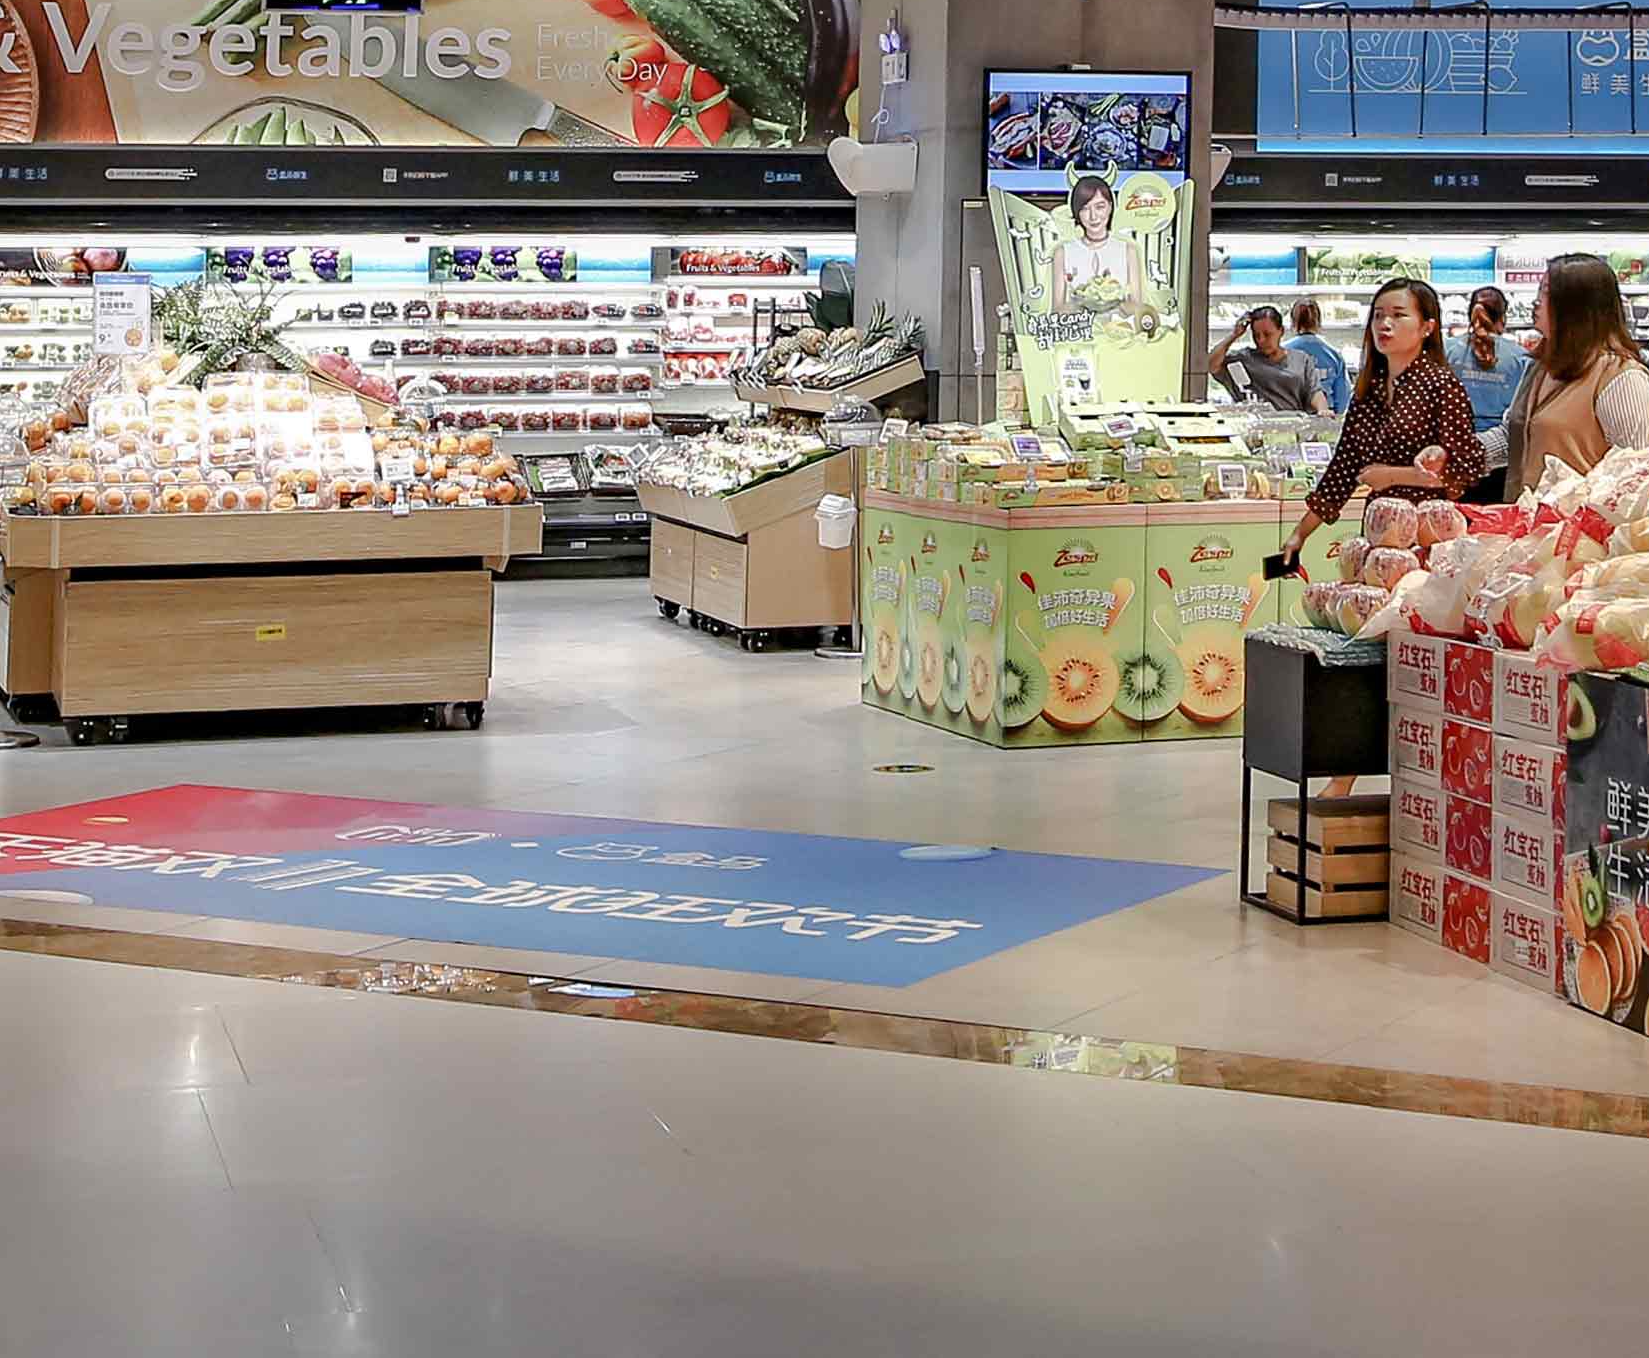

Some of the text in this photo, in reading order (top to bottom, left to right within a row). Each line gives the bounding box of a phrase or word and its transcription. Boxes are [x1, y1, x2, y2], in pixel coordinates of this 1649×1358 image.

[43, 3, 513, 93] Vegetables
[536, 23, 609, 48] Fresh
[536, 56, 669, 85] Every Day
[1399, 642, 1431, 670] 红宝石
[1505, 668, 1543, 699] 红宝石
[1399, 717, 1431, 748] 红宝石
[1502, 750, 1539, 782] 红宝石
[1401, 791, 1434, 822] 红宝石
[1503, 826, 1540, 862] 红宝石
[1400, 867, 1432, 901] 红宝石
[334, 871, 984, 944] 全球狂欢节
[1503, 908, 1540, 944] 红宝石
